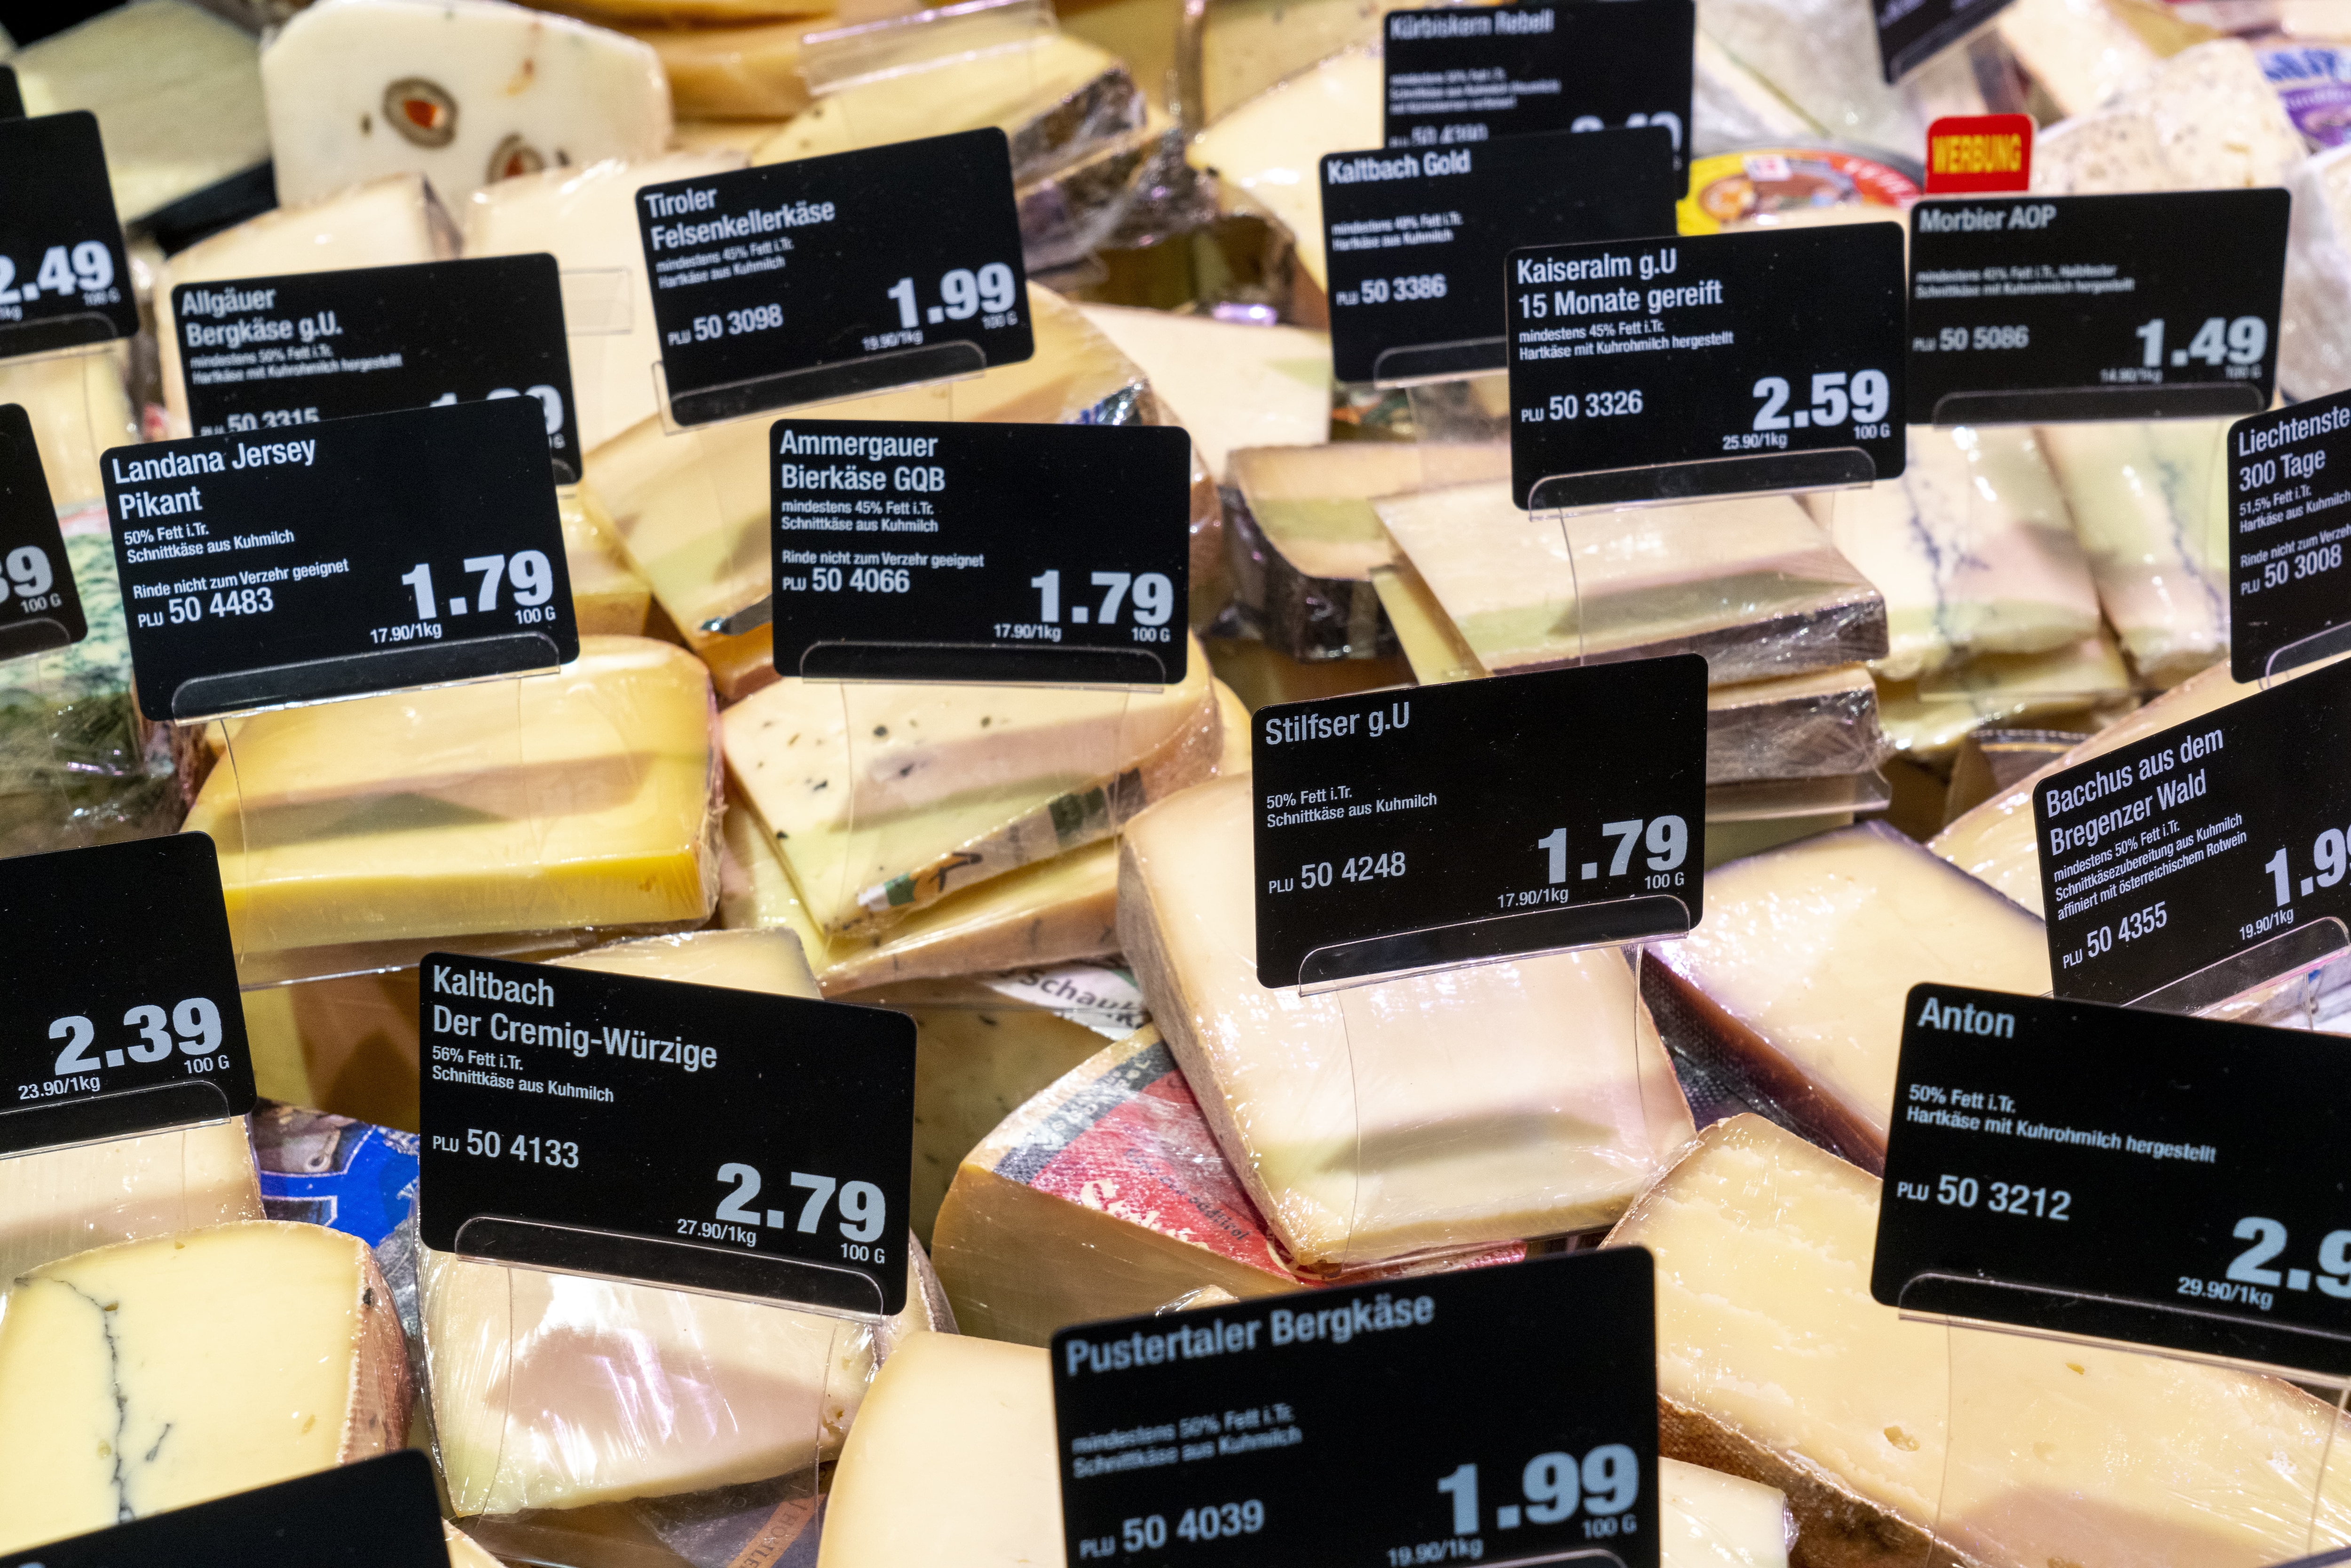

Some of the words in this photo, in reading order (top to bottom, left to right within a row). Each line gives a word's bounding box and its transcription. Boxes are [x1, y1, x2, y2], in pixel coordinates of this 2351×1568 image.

[1327, 154, 1420, 184] Kaltbach
[1422, 149, 1471, 176] Gold
[1932, 134, 2021, 173] WERBUNG
[643, 188, 717, 218] Tiroler
[1919, 207, 2006, 232] Morbier
[2007, 204, 2057, 229] AOP
[650, 200, 835, 251] Felsenkellerkäse
[1517, 252, 1632, 284] Kaiseralm
[1639, 247, 1677, 280] g.U
[181, 287, 276, 318] Allgäuer
[887, 262, 1016, 329] 1.99
[1360, 278, 1389, 304] 50
[1392, 273, 1447, 301] 3386
[1518, 292, 1547, 318] 15
[1554, 287, 1641, 316] Monate
[1647, 279, 1723, 315] gereift
[185, 317, 293, 349] Bergkäse
[298, 310, 343, 343] g.U.
[693, 314, 723, 341] 50
[726, 303, 783, 335] 3098
[1939, 327, 1969, 351] 50
[1972, 325, 2029, 350] 5086
[2136, 315, 2267, 368] 1.49
[1519, 343, 1572, 360] Hartkäse
[1573, 342, 1594, 356] mit
[1595, 336, 1670, 354] Kuhrohmilch
[1671, 331, 1734, 350] hergestellt
[1549, 394, 1578, 420] 50
[1585, 389, 1643, 418] 3326
[1752, 369, 1889, 431] 2.59
[779, 429, 939, 461] Ammergauer
[1722, 431, 1788, 450] 25.90/1kg
[111, 451, 226, 484] Landana
[231, 439, 316, 470] Jersey
[781, 463, 887, 491] Bierkäse
[893, 465, 945, 492] GQB
[2239, 459, 2276, 491] 300
[2280, 449, 2326, 479] Tage
[118, 486, 203, 520] Pikant
[2239, 496, 2272, 516] 51,5%
[2272, 489, 2293, 506] Fett
[2294, 484, 2312, 499] i.Tr.
[2239, 511, 2284, 533] Hartkäse
[2285, 505, 2304, 520] aus
[2305, 489, 2351, 513] Kuhmilch
[123, 528, 155, 546] 50%
[156, 525, 184, 541] Fett
[185, 521, 209, 537] i.Tr.
[781, 515, 853, 531] Schnittkäse
[855, 519, 879, 531] aus
[880, 518, 939, 532] Kuhmilch
[126, 542, 204, 564] Schnittkäse
[206, 539, 231, 553] aus
[233, 528, 295, 550] Kuhmilch
[2240, 549, 2269, 567] Rinde
[2270, 540, 2296, 559] nicht
[2296, 535, 2319, 551] zum
[2264, 559, 2289, 588] 50
[2294, 543, 2342, 579] 3008
[132, 582, 171, 599] Rinde
[173, 576, 208, 594] nicht
[209, 575, 238, 589] zum
[238, 566, 289, 585] Verzehr
[292, 558, 349, 581] geeignet
[401, 549, 553, 620] 1.79
[812, 567, 842, 592] 50
[849, 567, 910, 593] 4066
[1031, 569, 1174, 626] 1.79
[20, 596, 48, 613] 100
[49, 592, 62, 607] G
[168, 595, 202, 624] 50
[209, 586, 274, 617] 4483
[370, 621, 442, 644] 17.90/1kg
[994, 622, 1062, 642] 17.90/1kg
[1265, 713, 1360, 745] Stilfser
[1368, 701, 1409, 737] g.U
[2046, 765, 2133, 818] Bacchus
[2138, 749, 2174, 780] aus
[2179, 729, 2223, 763] dem
[1266, 792, 1296, 809] 50%
[1300, 788, 1327, 804] Fett
[1330, 785, 1352, 800] i.Tr.
[1267, 806, 1344, 828] Schnittkäse
[1348, 803, 1372, 817] aus
[1376, 792, 1437, 813] Kuhmilch
[2050, 795, 2153, 856] Bregenzer
[2156, 768, 2206, 811] Wald
[1538, 814, 1688, 884] 1.79
[2053, 849, 2113, 882] mindestens
[2114, 835, 2138, 857] 50%
[2140, 826, 2161, 846] Fett
[2162, 819, 2180, 837] i.Tr.
[2055, 843, 2174, 902] Schnittkäsezubereitung
[2175, 834, 2194, 851] aus
[2196, 812, 2242, 842] Kuhmilch
[2264, 824, 2351, 907] 1.9
[1268, 877, 1294, 894] PLU
[1301, 861, 1333, 889] 50
[1341, 851, 1406, 882] 4248
[2057, 891, 2098, 921] affiniert
[2099, 883, 2117, 902] mit
[2118, 849, 2204, 894] österreichischem
[2206, 831, 2247, 858] Rotwein
[1497, 887, 1569, 908] 17.90/1kg
[2086, 925, 2112, 958] 50
[2118, 900, 2167, 942] 4355
[2239, 908, 2294, 940] 19.90/1kg
[434, 964, 554, 1007] Kaltbach
[47, 997, 222, 1076] 2.39
[1917, 997, 2014, 1038] Anton
[434, 1004, 481, 1037] Der
[490, 1012, 717, 1072] Cremig-Würzige
[183, 1056, 213, 1074] 100
[217, 1054, 229, 1070] G
[432, 1045, 464, 1063] 56%
[467, 1049, 496, 1067] Fett
[499, 1053, 523, 1071] i.Tr.
[17, 1075, 101, 1100] 23.90/1kg
[432, 1064, 514, 1089] Schnittkäse
[518, 1079, 544, 1093] aus
[547, 1079, 614, 1103] Kuhmilch
[1909, 1083, 1947, 1104] 50%
[1950, 1088, 1984, 1109] Fett
[1988, 1094, 2015, 1113] i.Tr.
[466, 1128, 500, 1158] 50
[509, 1134, 579, 1168] 4133
[1906, 1105, 1980, 1130] Hartkäse
[1984, 1118, 2012, 1135] mit
[2016, 1119, 2122, 1149] Kuhrohmilch
[2125, 1135, 2216, 1163] hergestellt
[715, 1162, 886, 1243] 2.79
[1937, 1174, 1979, 1207] 50
[1988, 1182, 2071, 1221] 3212
[677, 1218, 756, 1247] 27.90/1kg
[2177, 1276, 2273, 1310] 29.90/1kg
[1066, 1319, 1261, 1375] Pustertaler
[1270, 1293, 1434, 1345] Bergkäse
[1437, 1443, 1639, 1535] 1.99
[1123, 1514, 1166, 1552] 50
[1176, 1499, 1264, 1541] 4039
[1388, 1538, 1483, 1566] 19.90/1kg
